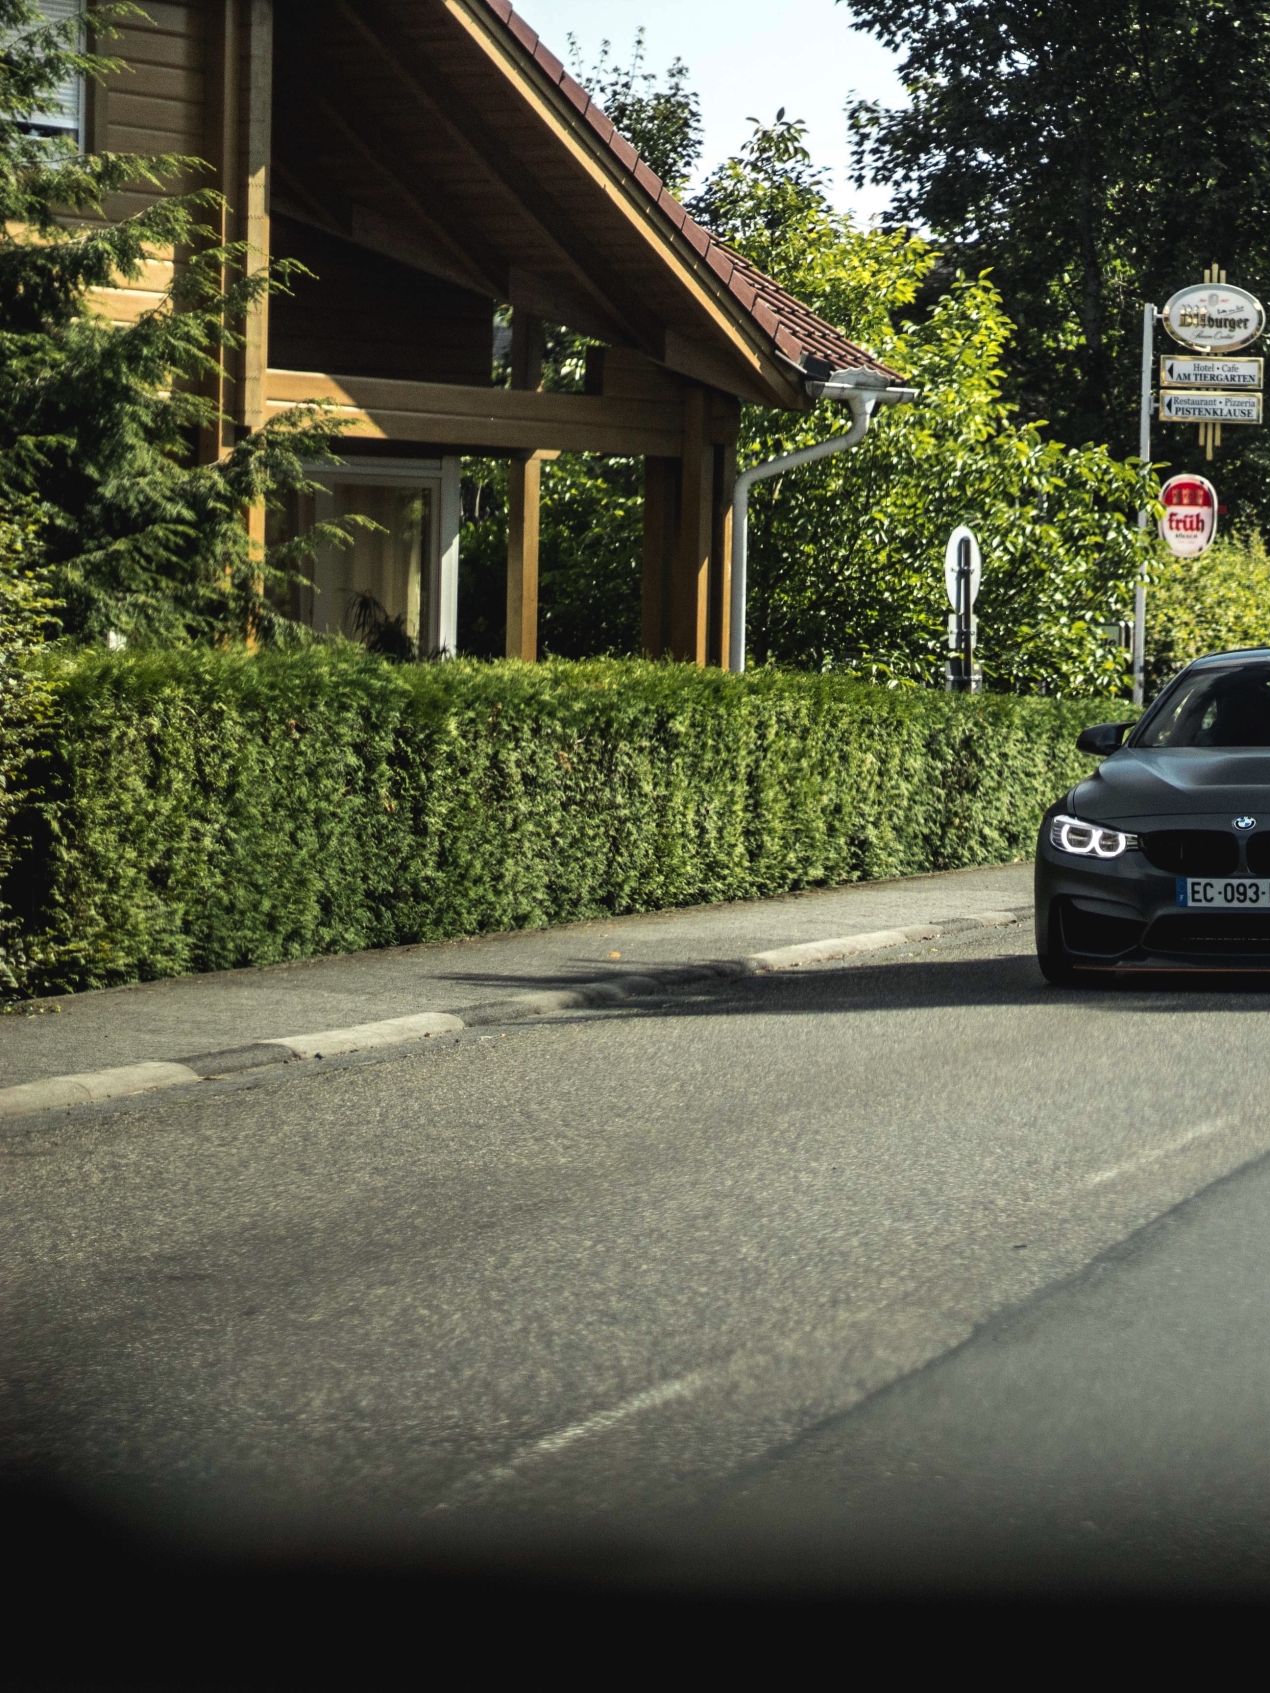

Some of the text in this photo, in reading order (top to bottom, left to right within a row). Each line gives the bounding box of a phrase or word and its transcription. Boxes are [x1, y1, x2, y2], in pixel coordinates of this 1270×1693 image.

[1193, 363, 1239, 373] Hotel Cafe
[1176, 373, 1256, 383] AM TIERGARTEN
[1173, 396, 1256, 408] Restaurant Pizzeria
[1175, 407, 1254, 418] PISTENKLAUSE
